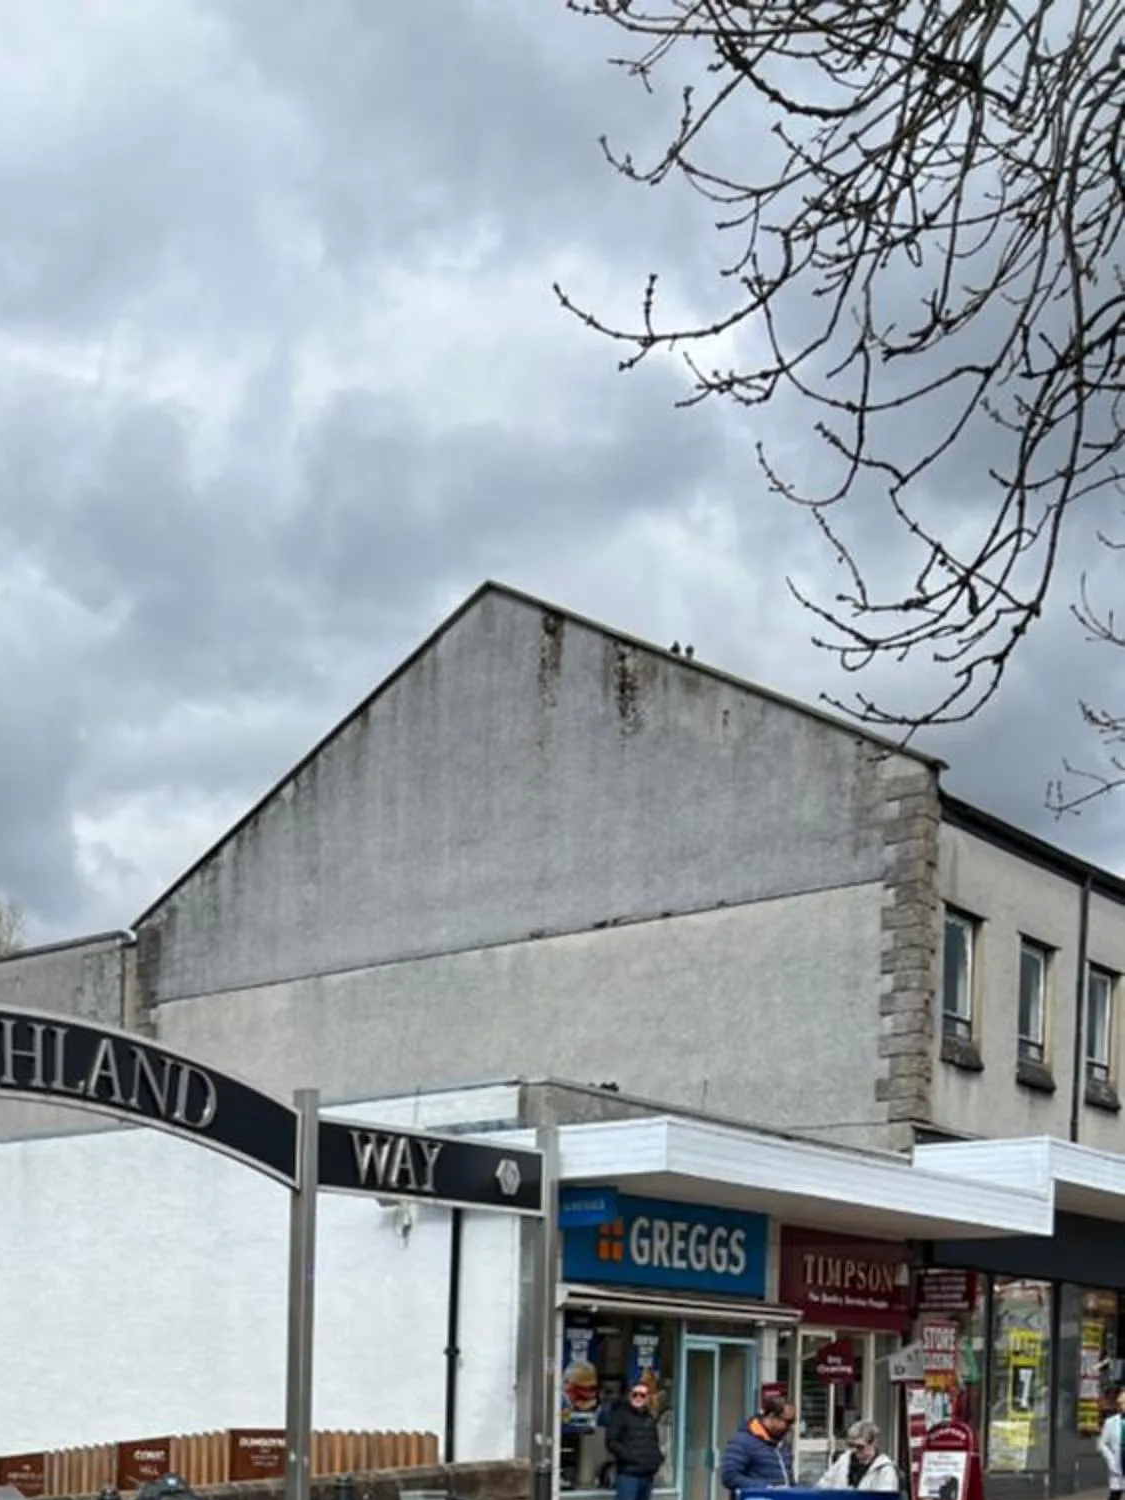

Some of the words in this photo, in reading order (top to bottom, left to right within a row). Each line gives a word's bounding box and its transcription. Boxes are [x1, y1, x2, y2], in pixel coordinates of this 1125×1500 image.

[348, 1130, 443, 1193] WAY
[630, 1216, 747, 1276] GREGGS
[804, 1253, 894, 1293] TIMPSON
